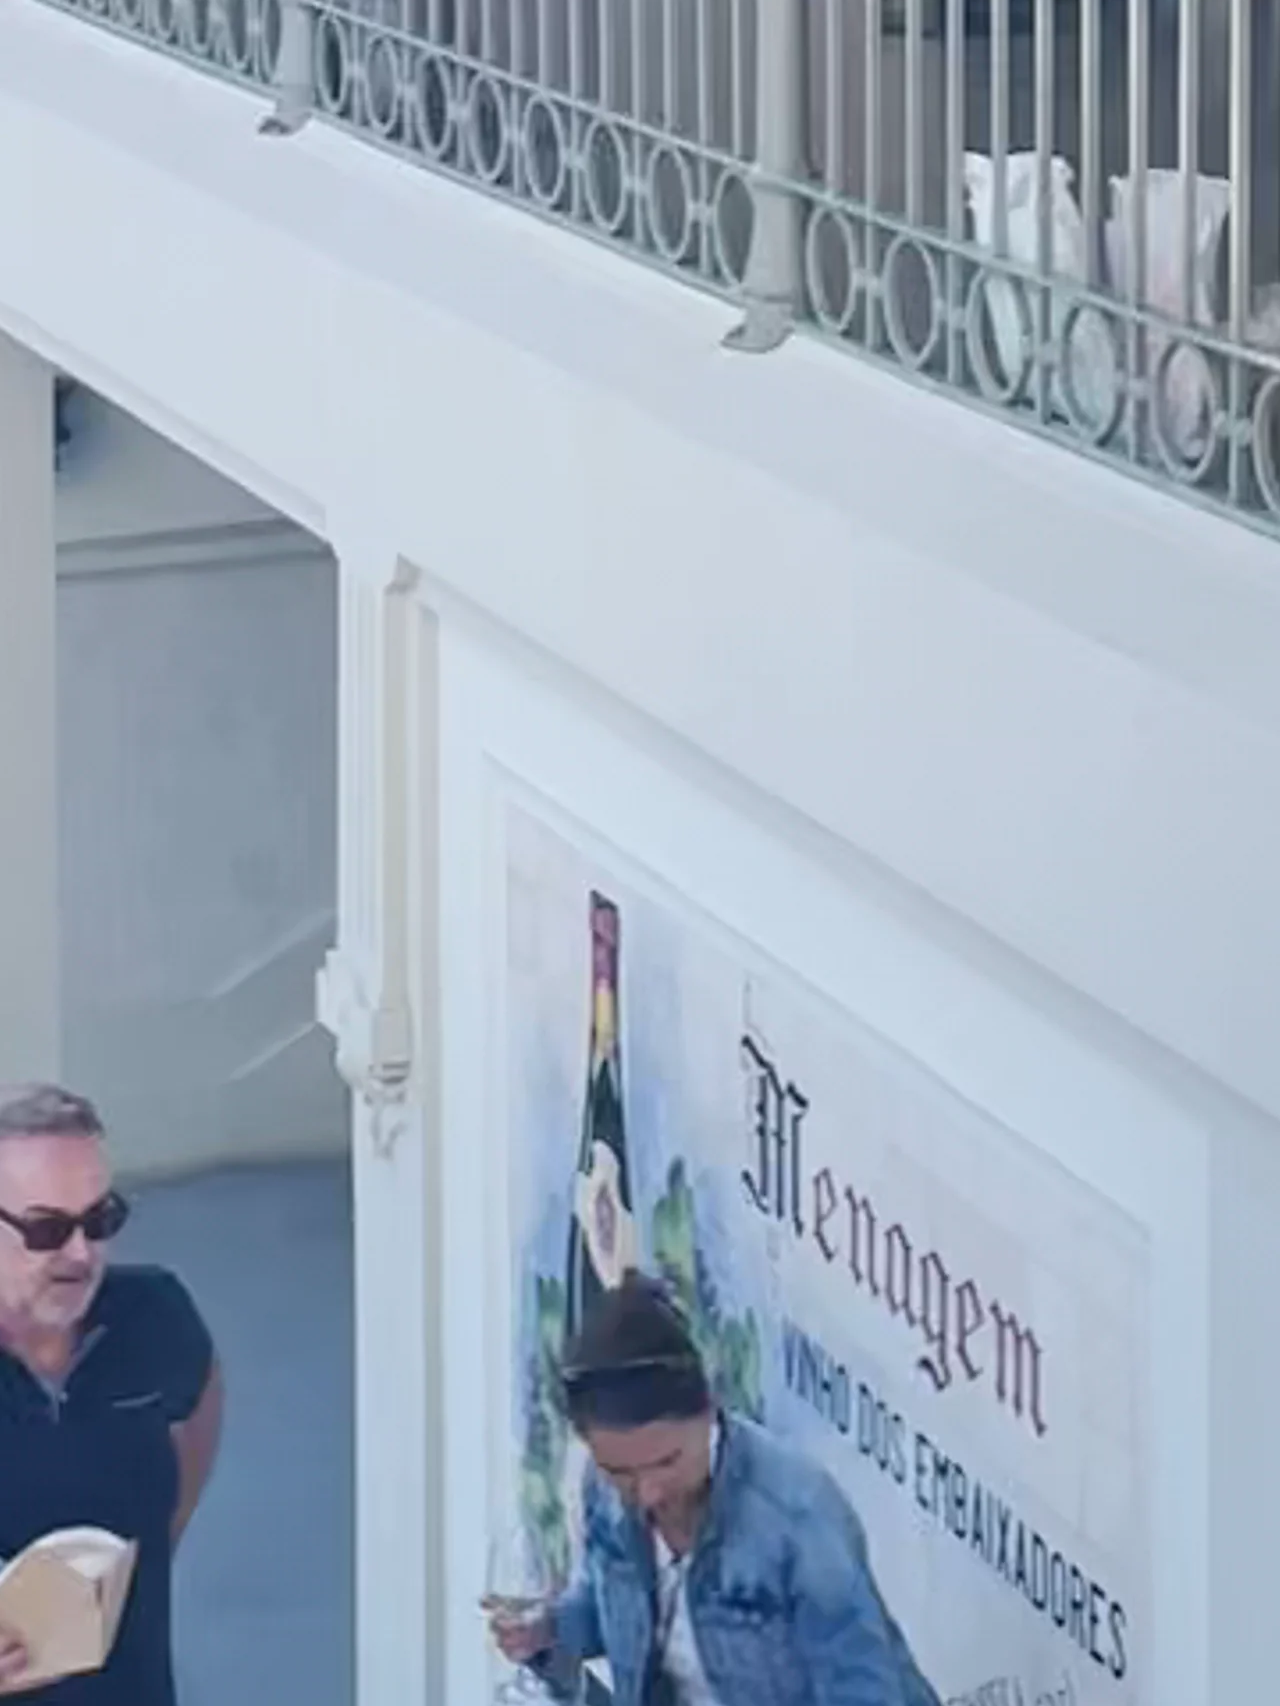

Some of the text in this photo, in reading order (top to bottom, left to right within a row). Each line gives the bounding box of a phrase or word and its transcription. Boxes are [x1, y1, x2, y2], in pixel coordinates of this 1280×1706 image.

[741, 1035, 1047, 1437] Menagem
[782, 1317, 1125, 1679] VINHO DOS EMBAIXADORES
